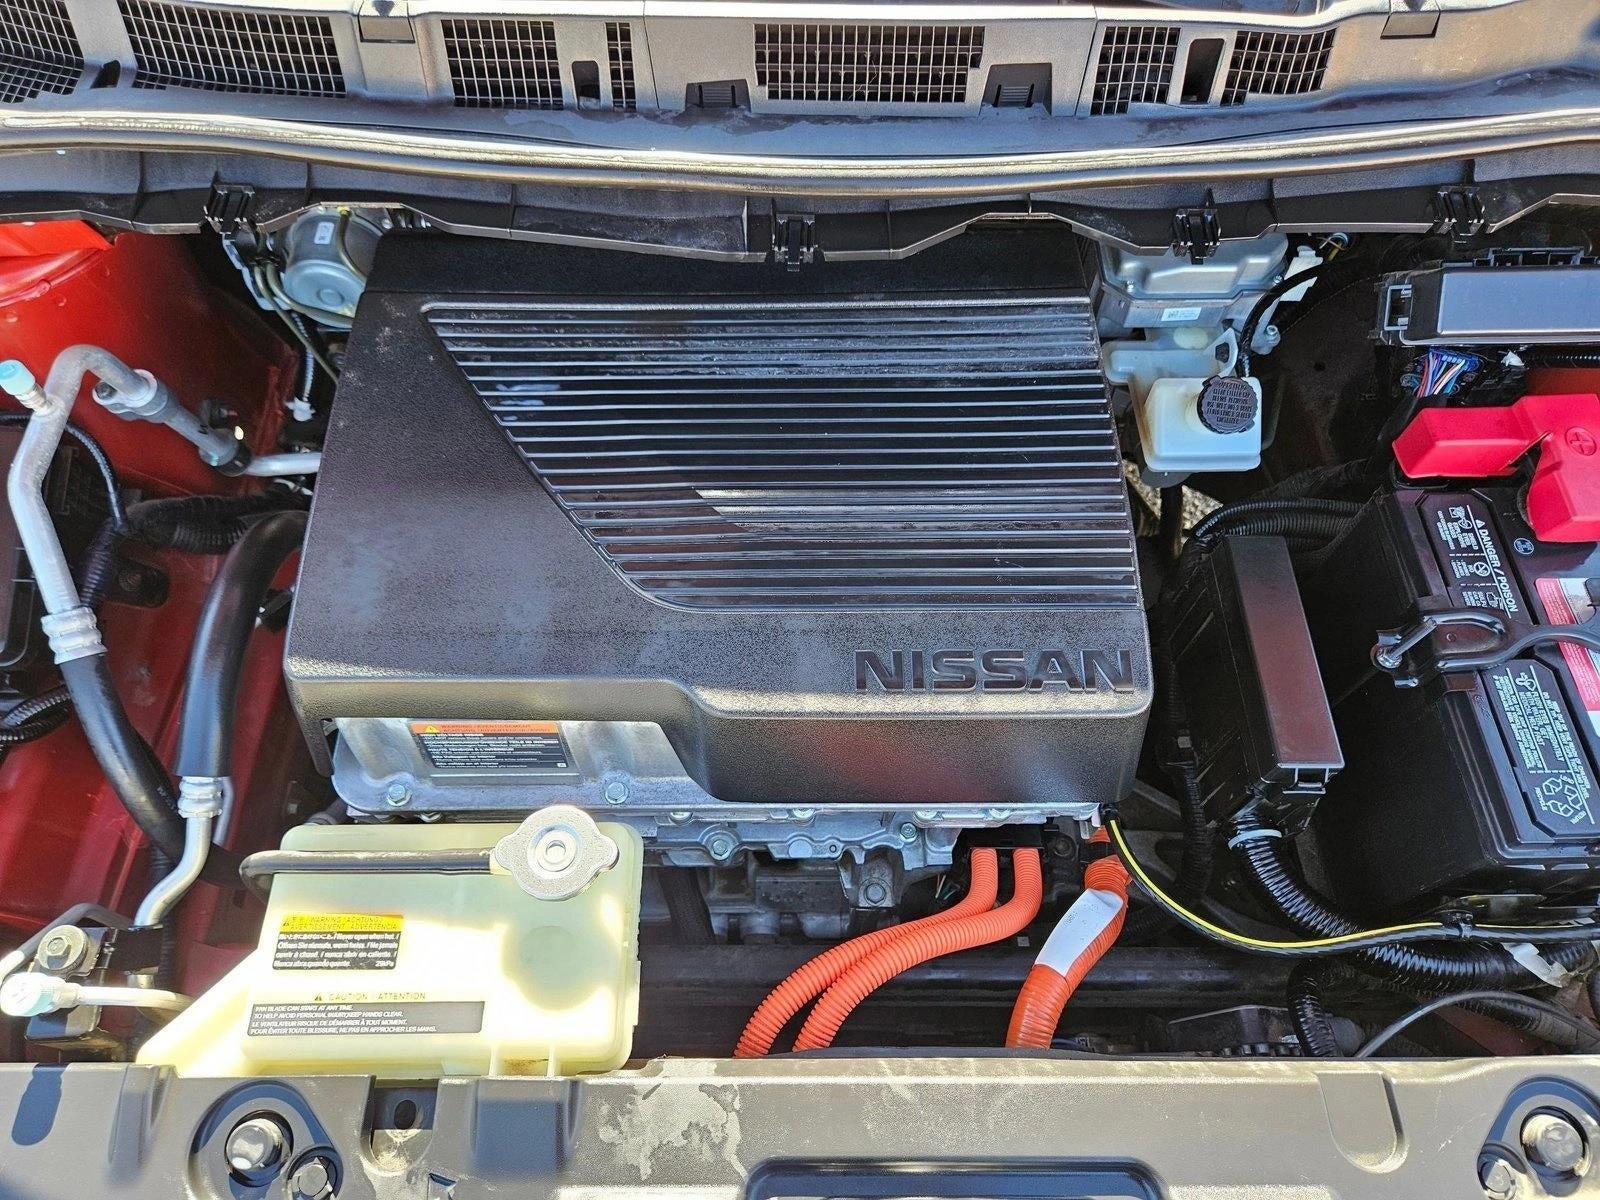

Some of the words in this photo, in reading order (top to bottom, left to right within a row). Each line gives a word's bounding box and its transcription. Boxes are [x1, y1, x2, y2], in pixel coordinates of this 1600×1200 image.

[1478, 528, 1501, 566] DANGER
[1496, 576, 1518, 611] POISON
[854, 649, 1134, 694] NISSAN
[1518, 692, 1533, 714] MEDICAL
[1527, 716, 1539, 729] HELP
[1533, 731, 1545, 745] FAST
[1524, 691, 1536, 705] WITH
[1538, 727, 1549, 738] GET
[1531, 691, 1544, 709] FLUSH
[1538, 710, 1549, 723] EYES
[1544, 724, 1564, 761] IMMEDIATELY
[378, 992, 426, 1000] ATTENTION
